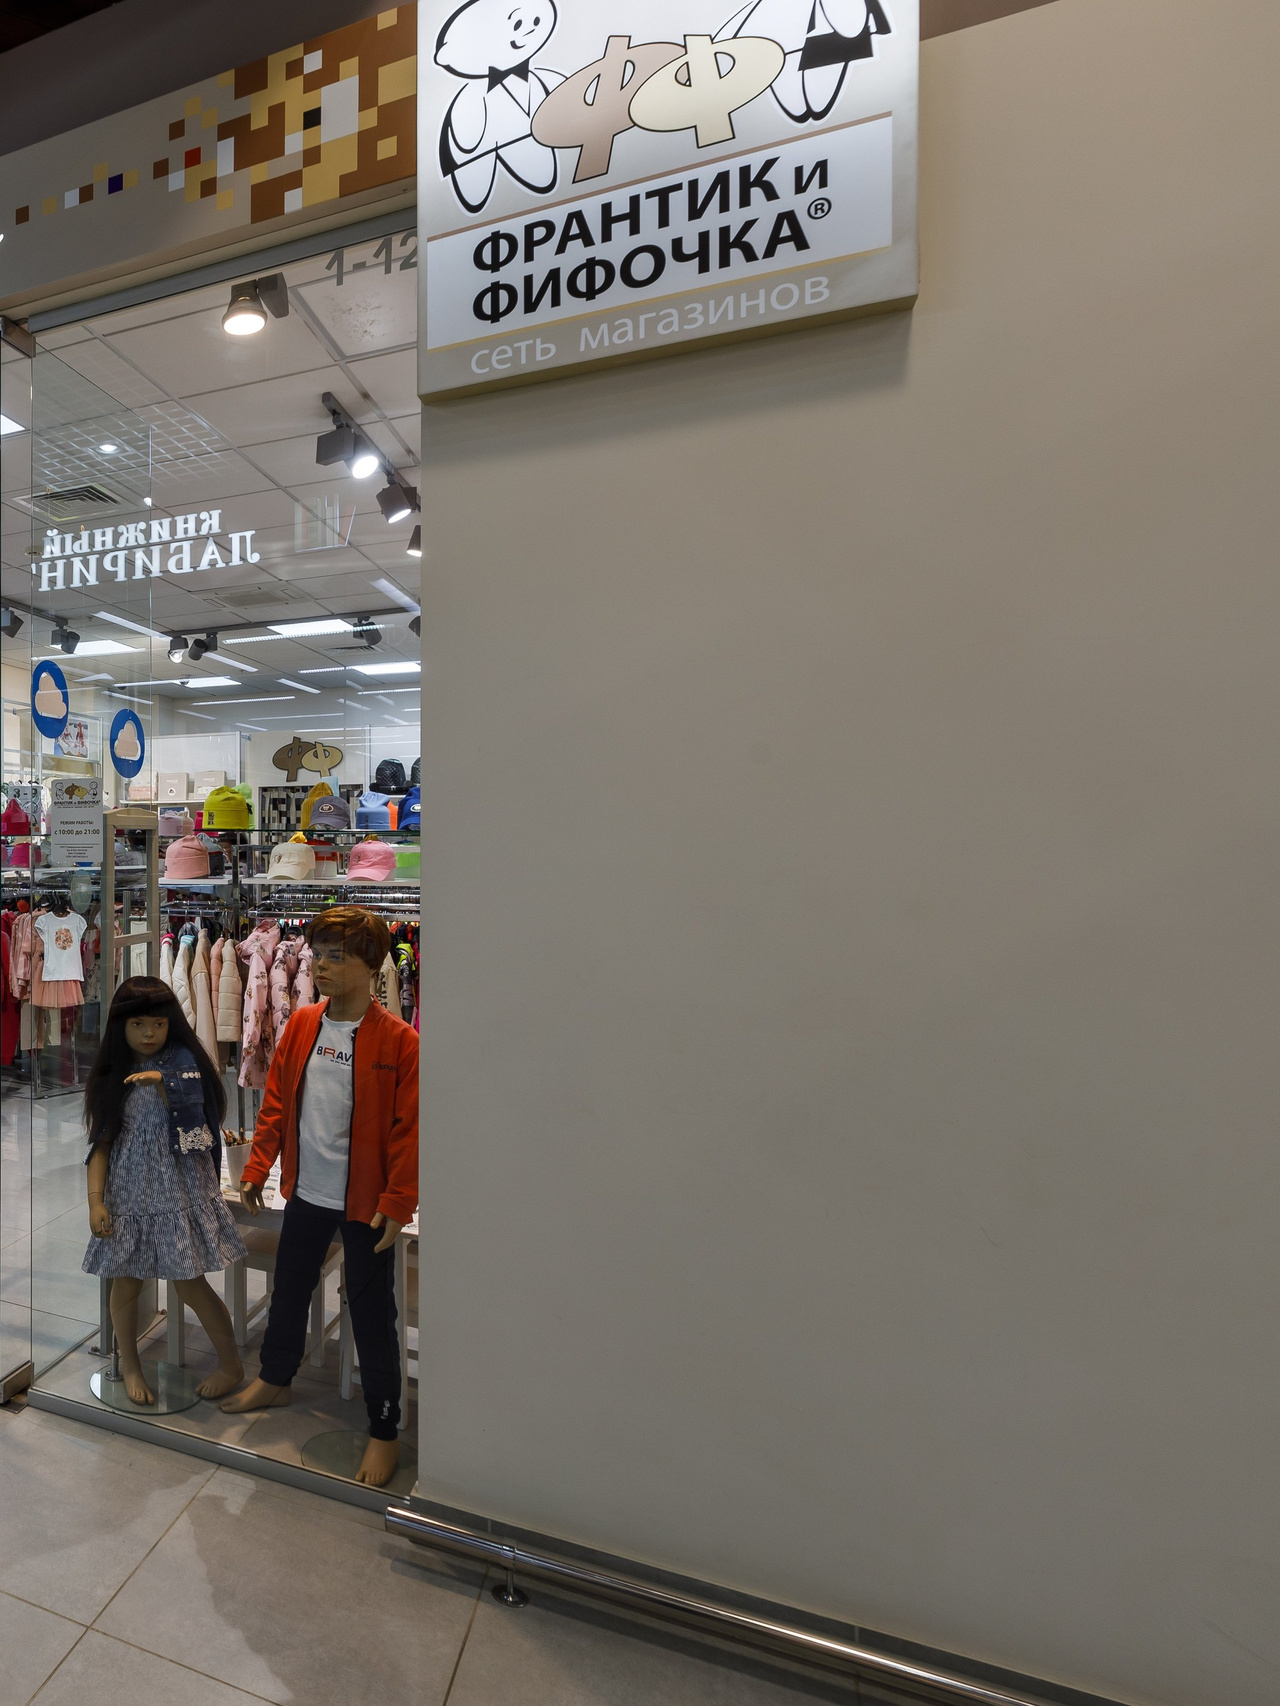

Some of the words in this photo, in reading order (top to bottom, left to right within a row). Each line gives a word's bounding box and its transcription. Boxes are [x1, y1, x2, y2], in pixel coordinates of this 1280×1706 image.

[473, 156, 781, 273] ФРАНТИК
[794, 159, 828, 195] и
[471, 339, 556, 374] сеть
[580, 276, 831, 352] магазинов
[59, 828, 74, 836] 10:00
[83, 828, 101, 836] 21:00
